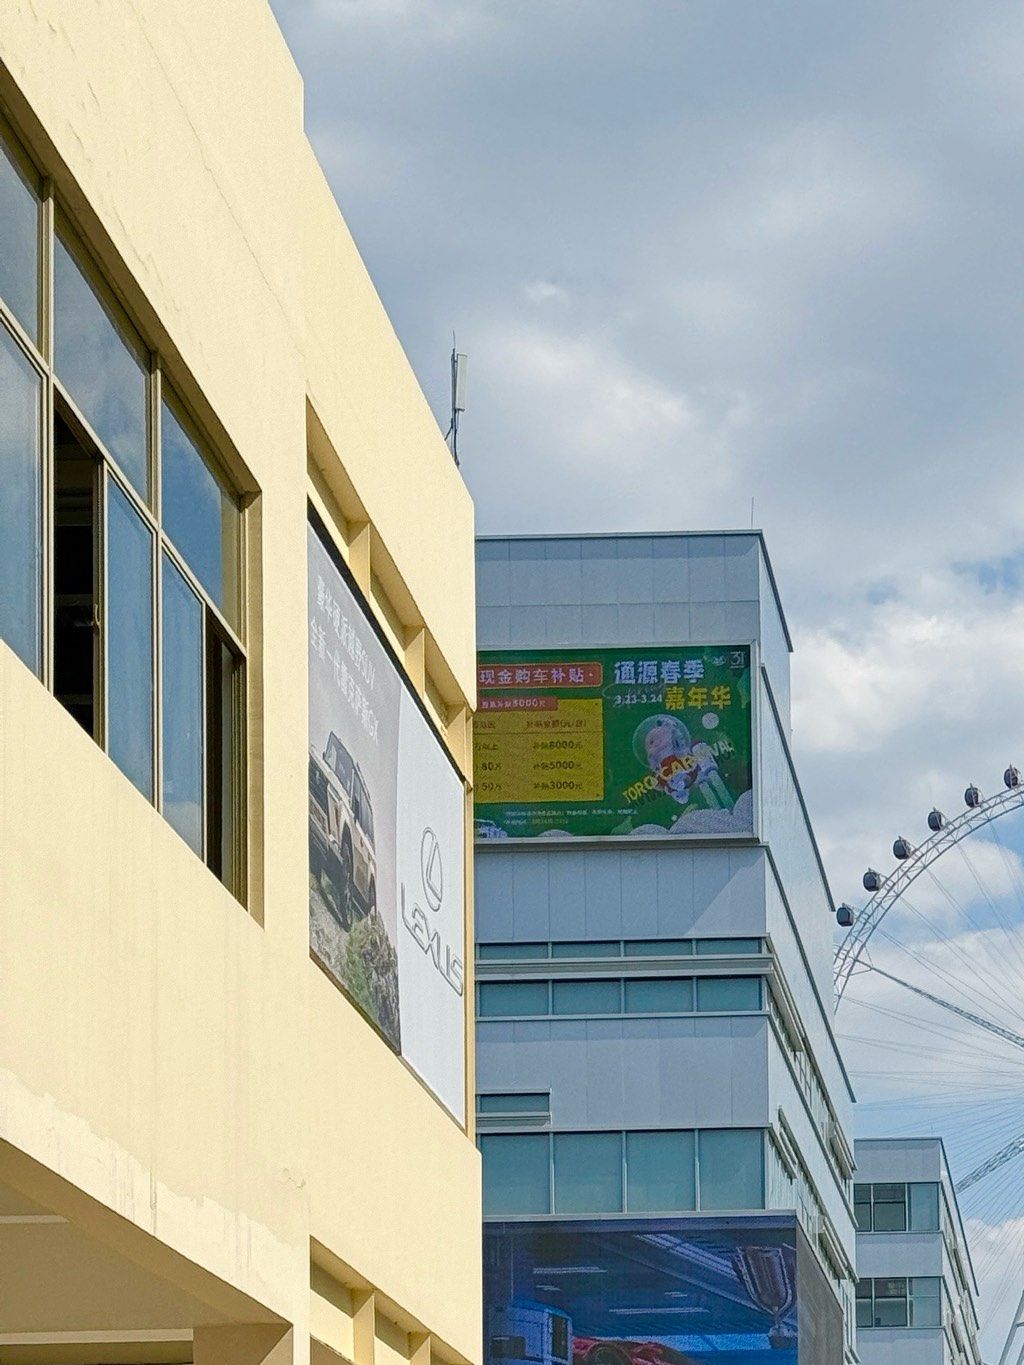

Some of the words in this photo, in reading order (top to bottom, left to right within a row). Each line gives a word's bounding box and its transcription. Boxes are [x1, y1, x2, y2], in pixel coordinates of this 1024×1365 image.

[479, 667, 585, 684] 现金购车补贴
[614, 660, 705, 684] 通源春季
[665, 685, 732, 710] 嘉年华
[659, 740, 735, 780] CARVAL
[400, 882, 463, 997] LEXUS
